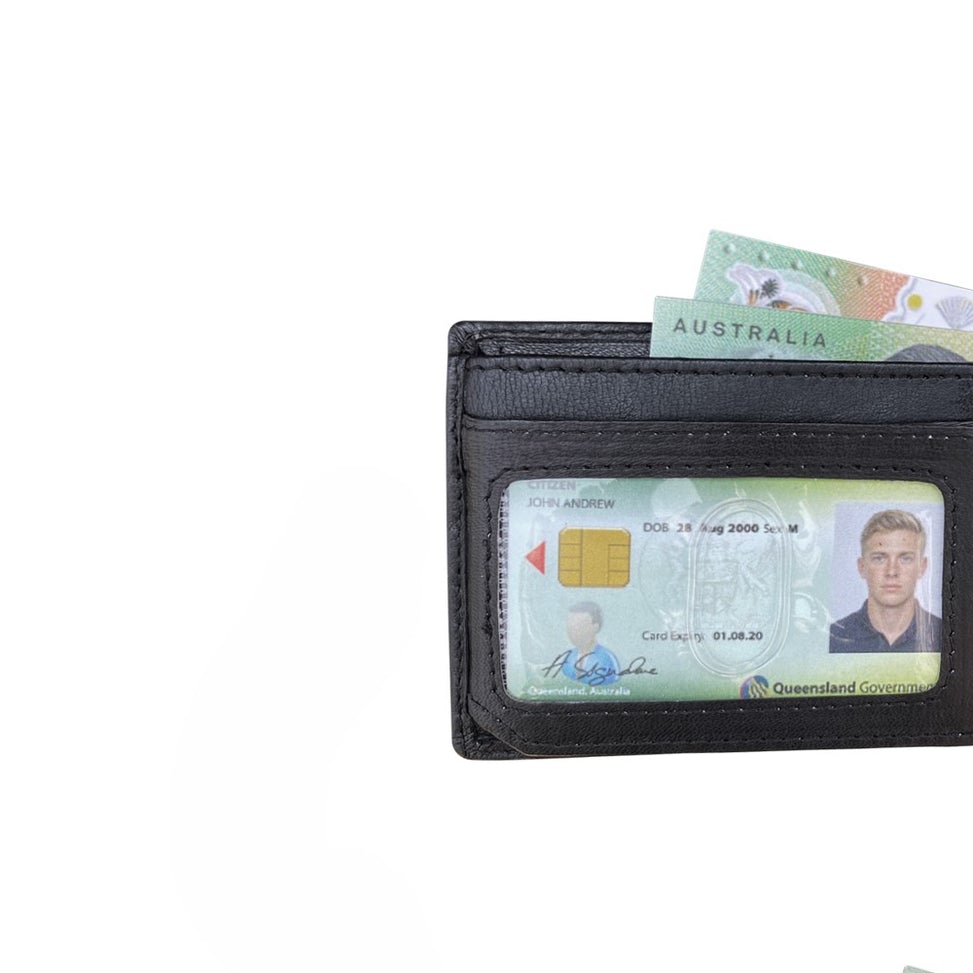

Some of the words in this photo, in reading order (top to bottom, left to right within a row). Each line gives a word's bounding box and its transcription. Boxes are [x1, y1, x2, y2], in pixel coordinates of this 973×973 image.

[673, 317, 827, 348] AUSTRALIA
[526, 497, 559, 508] JOHN
[563, 498, 615, 509] ANDREW
[642, 522, 669, 533] DOB
[676, 523, 692, 533] 28
[727, 523, 759, 533] 2000
[788, 524, 798, 533] M
[642, 630, 668, 641] Card
[713, 631, 763, 641] 01.08.20
[589, 686, 631, 696] Australia
[773, 681, 855, 695] Queensland
